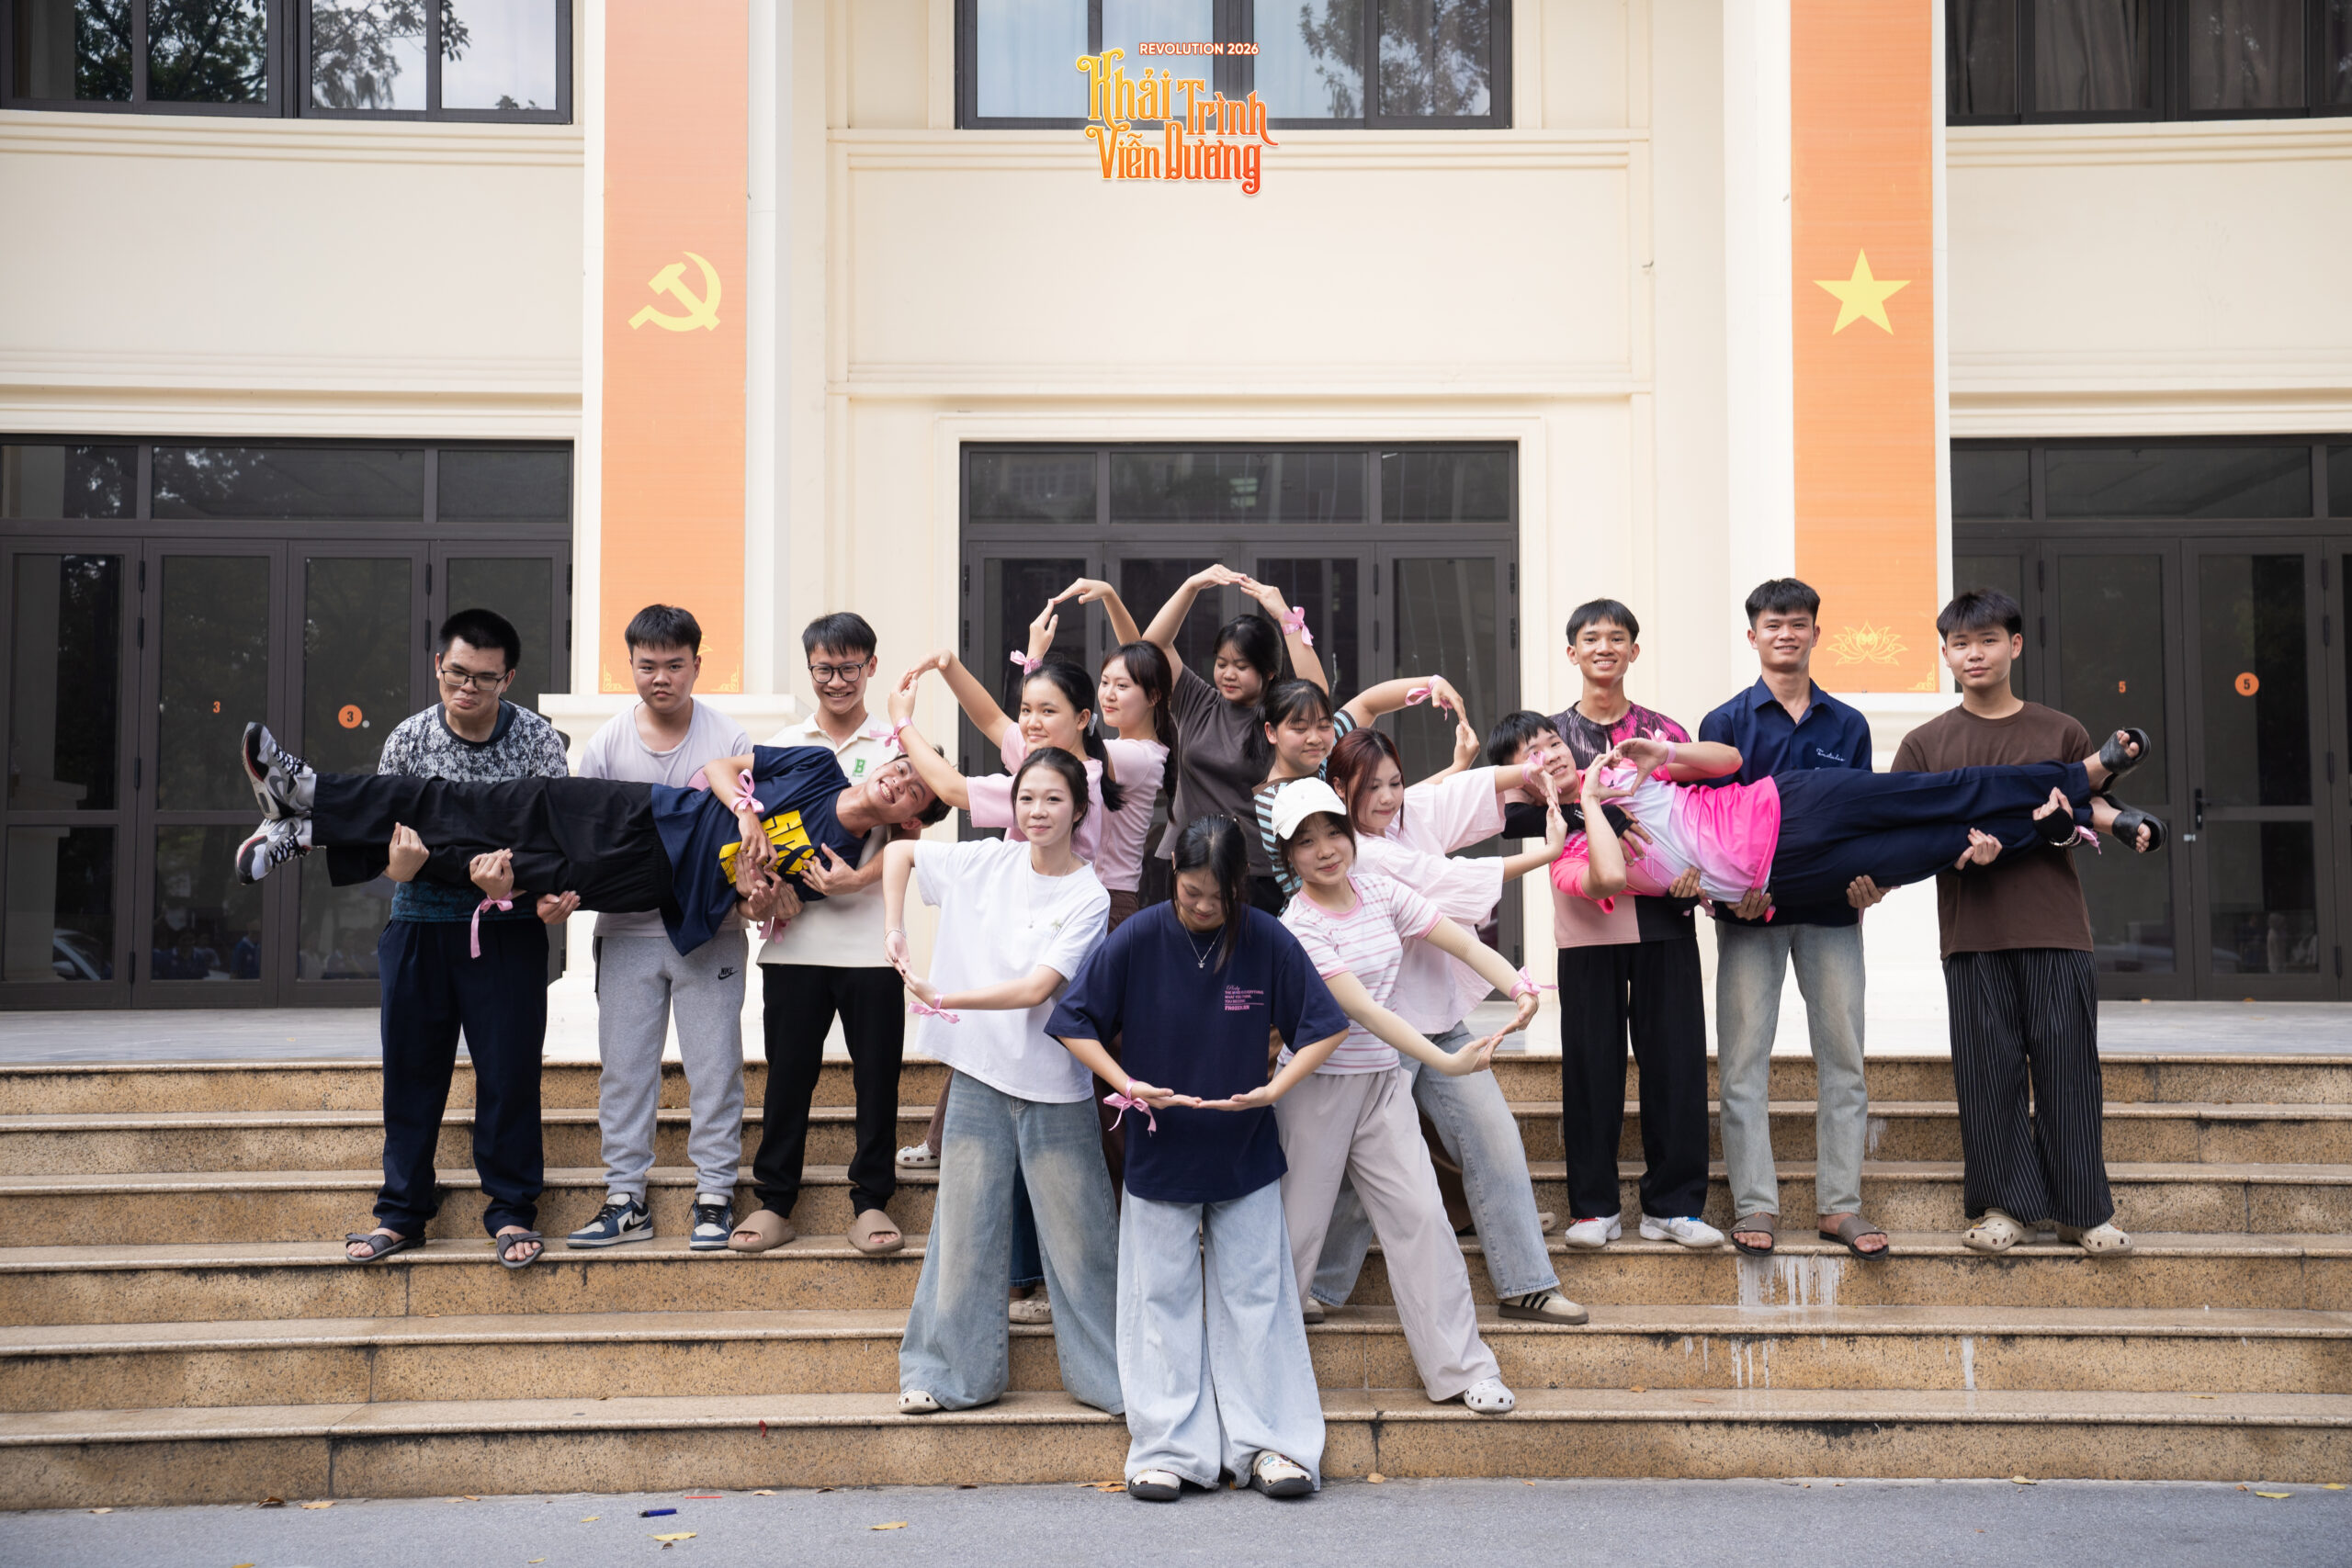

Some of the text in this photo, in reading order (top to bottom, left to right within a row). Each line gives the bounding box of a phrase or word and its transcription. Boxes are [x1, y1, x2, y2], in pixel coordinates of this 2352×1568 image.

[2119, 681, 2126, 694] 5
[212, 701, 220, 714] 3
[346, 711, 354, 723] 3
[854, 758, 865, 773] B
